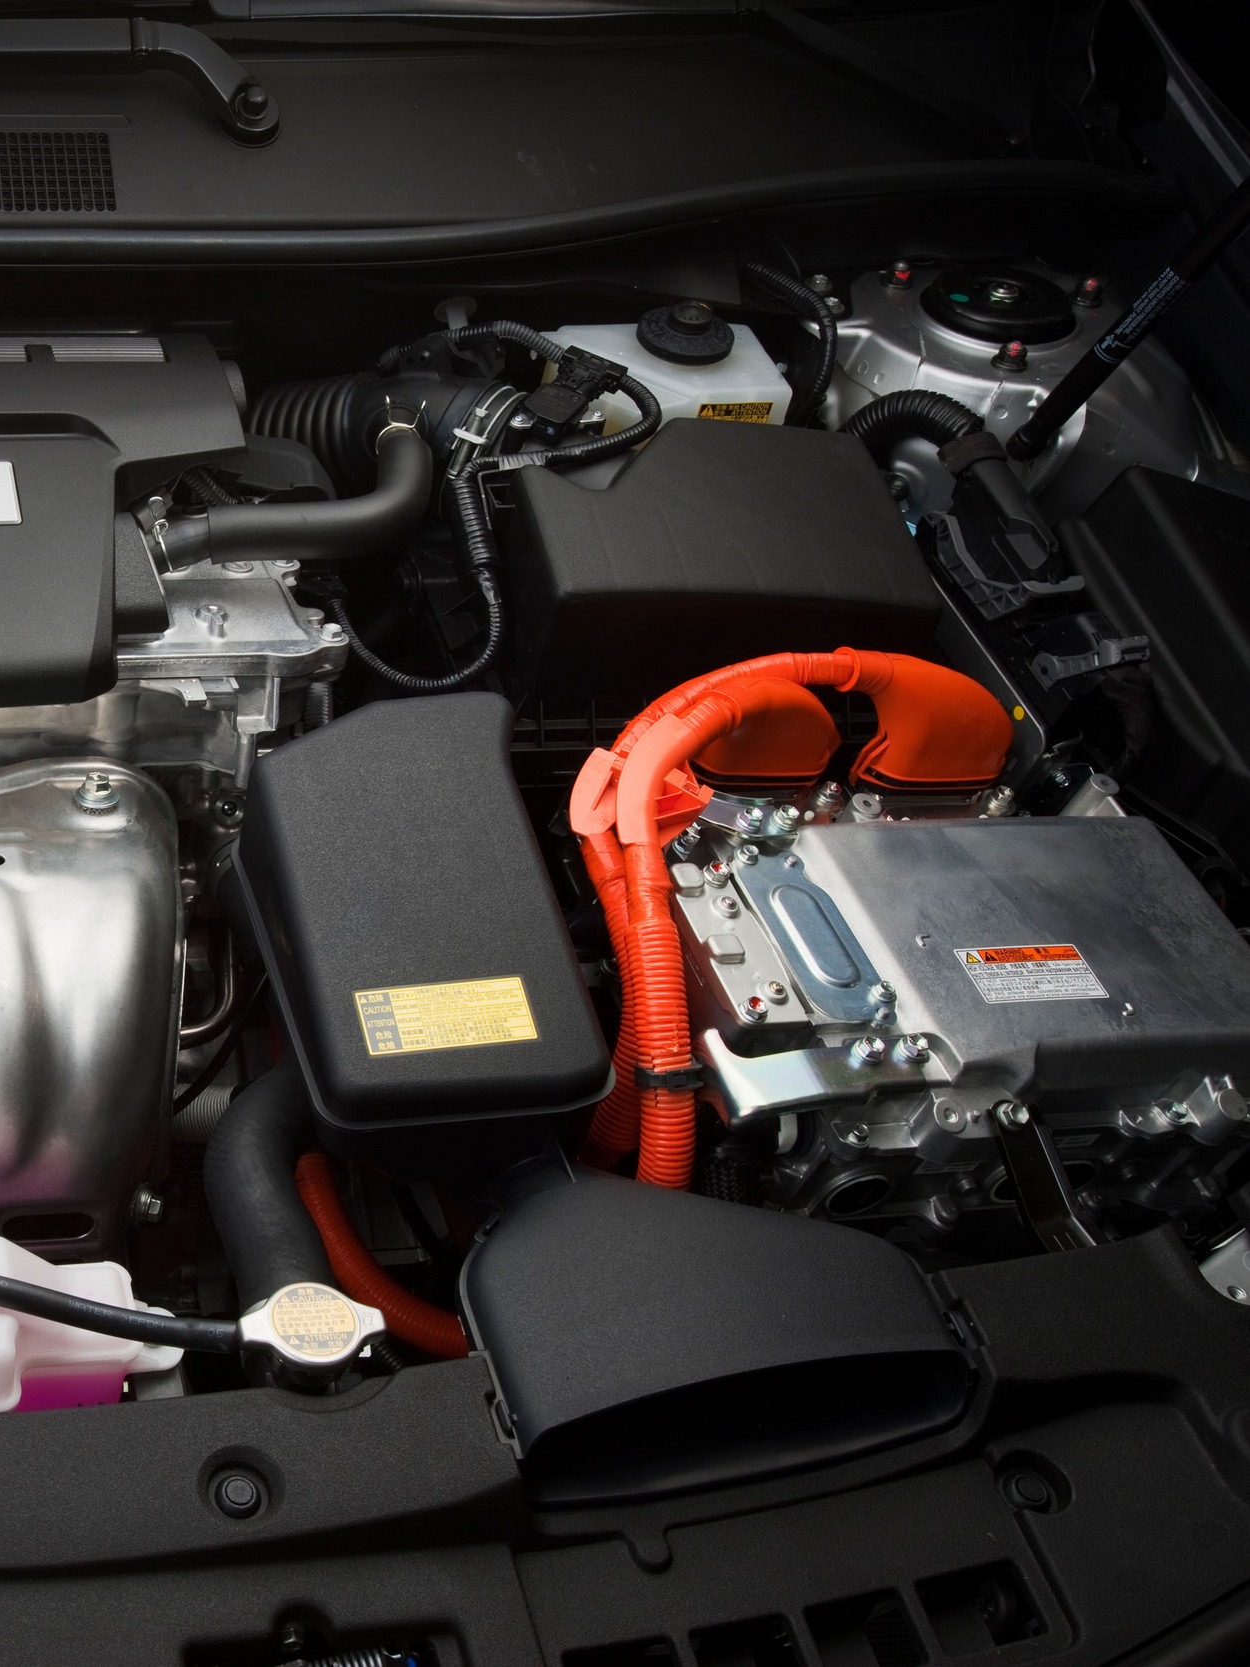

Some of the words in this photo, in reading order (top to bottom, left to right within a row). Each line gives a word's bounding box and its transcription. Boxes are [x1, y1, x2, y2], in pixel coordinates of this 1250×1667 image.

[363, 1005, 392, 1015] CAUTION
[368, 1018, 396, 1028] ATTENTION
[291, 1294, 332, 1303] CAUTION
[68, 1300, 113, 1318] WATER
[304, 1333, 348, 1342] ATTENTION
